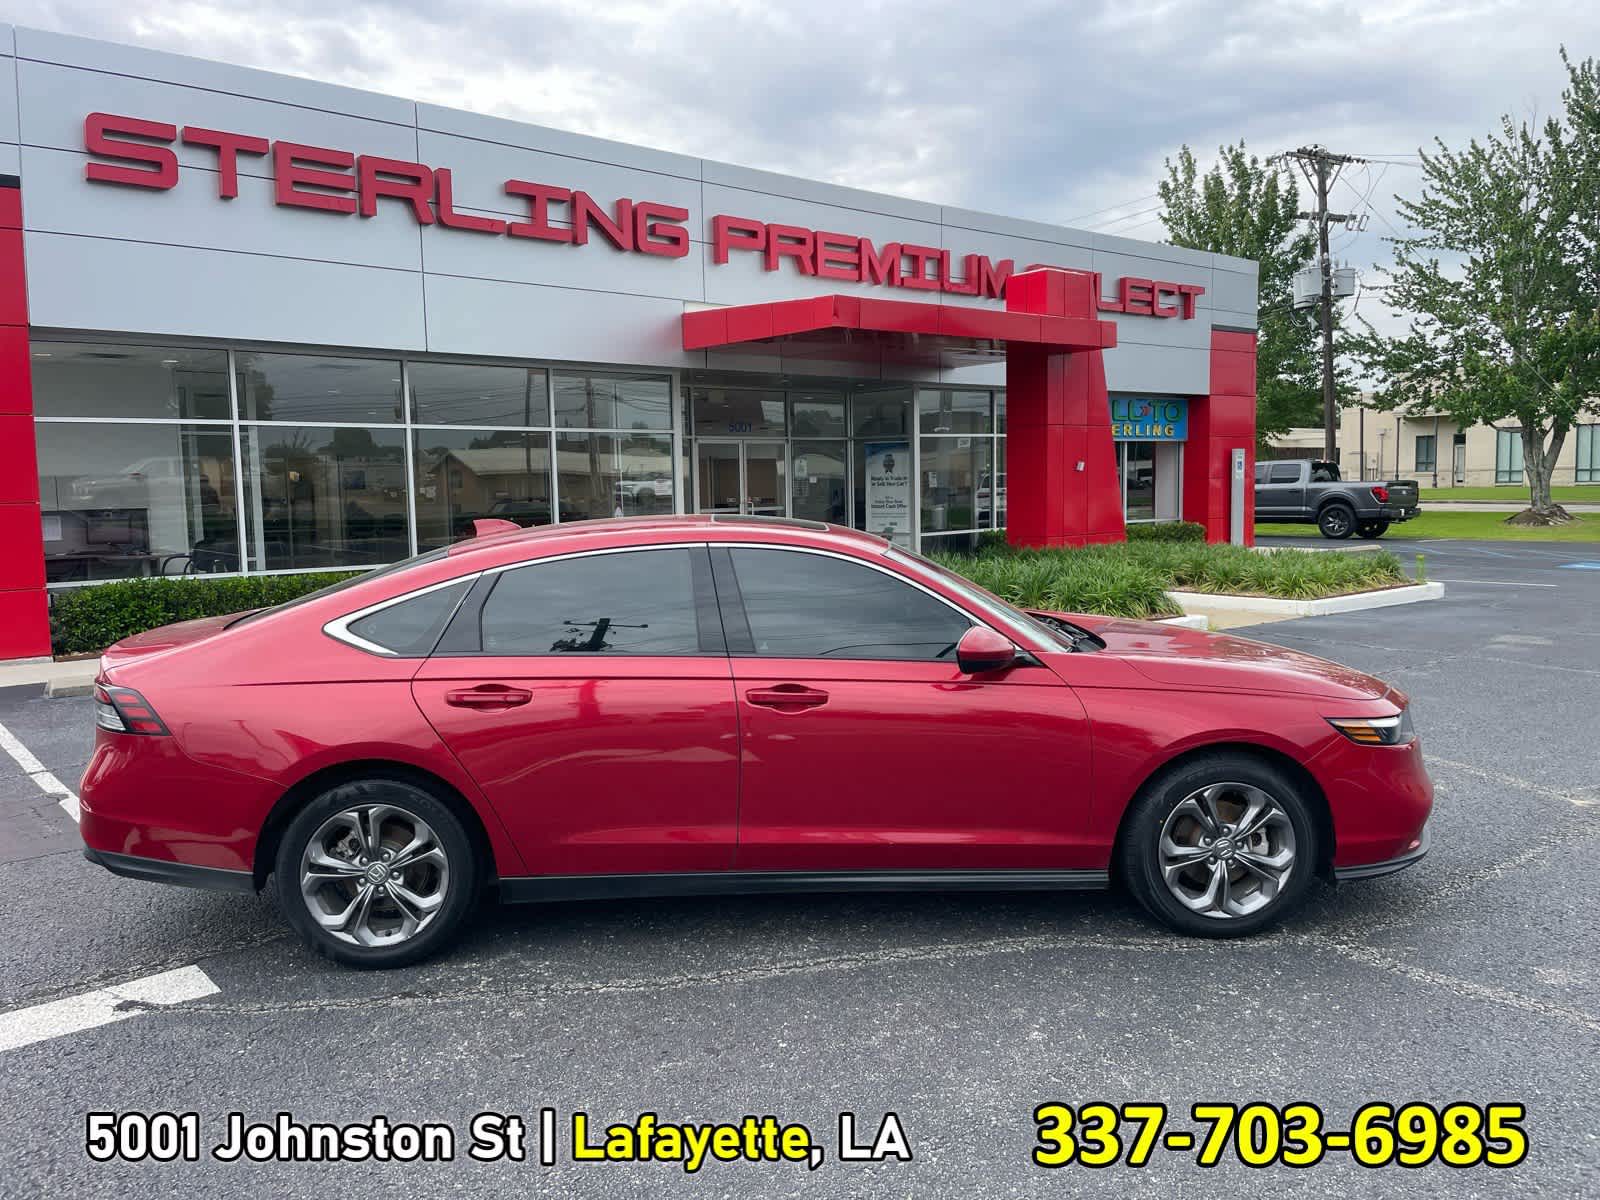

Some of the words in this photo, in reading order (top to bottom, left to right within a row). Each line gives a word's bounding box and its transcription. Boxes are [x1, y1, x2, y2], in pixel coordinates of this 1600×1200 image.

[85, 112, 689, 258] STERLING
[712, 215, 1014, 300] PREMIUM
[1027, 264, 1206, 320] LECT
[727, 422, 752, 433] 5001
[1111, 424, 1175, 437] ERLING
